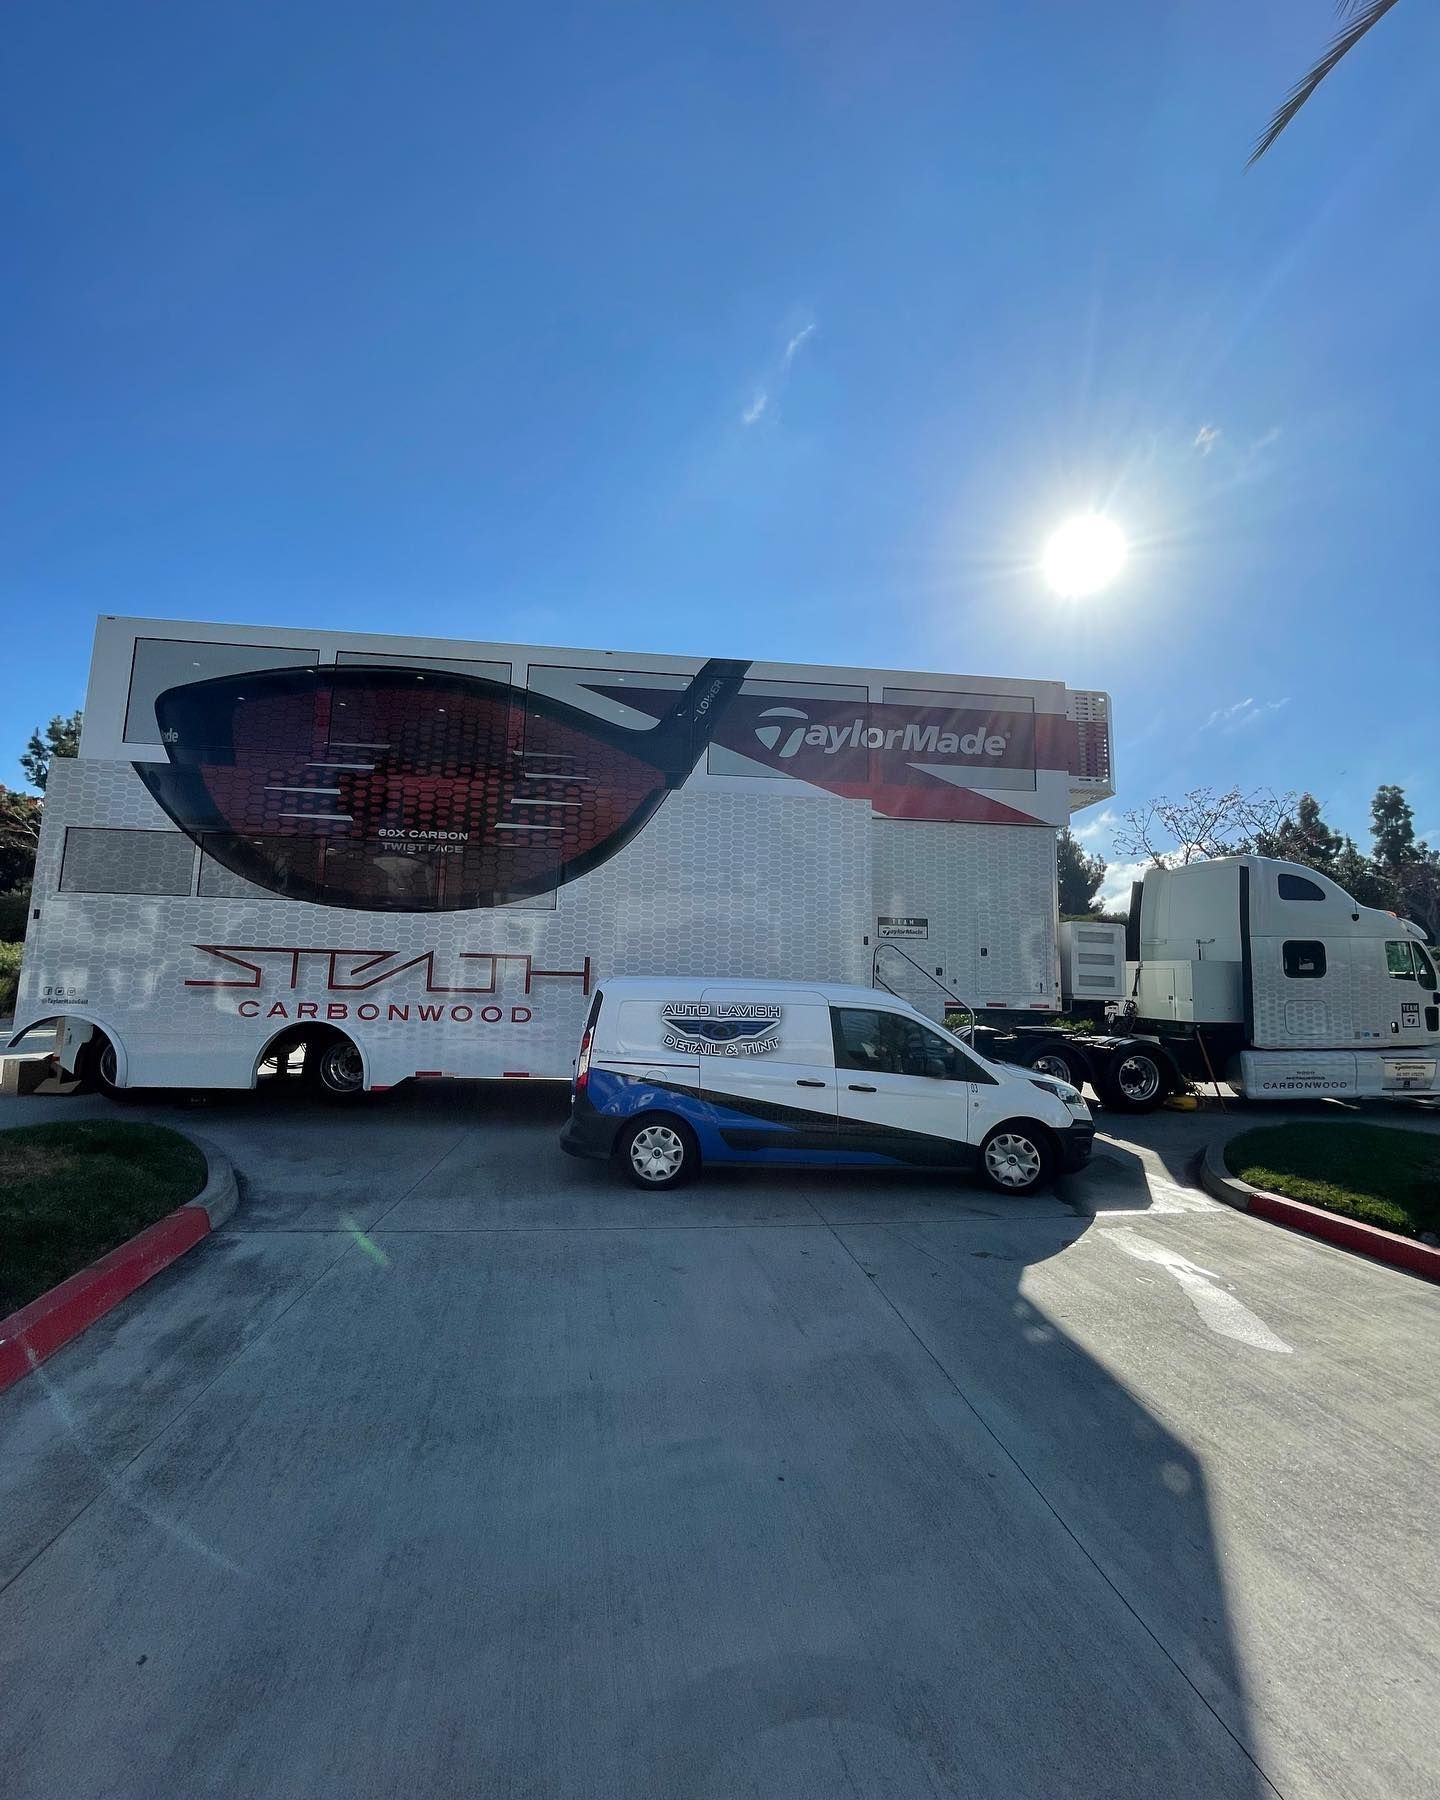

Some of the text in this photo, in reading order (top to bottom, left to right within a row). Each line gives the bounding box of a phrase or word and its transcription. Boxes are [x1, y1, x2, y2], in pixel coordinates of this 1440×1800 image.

[696, 679, 724, 715] LOWER
[754, 706, 1007, 758] TaylorMade
[378, 828, 469, 841] 60X CARBON
[382, 842, 464, 854] TWIST FACE
[238, 1000, 533, 1024] CARBONWOOD
[662, 1003, 781, 1018] AUTO LAVISH
[663, 1033, 780, 1056] DETAIL & TINT
[1262, 1081, 1348, 1090] CARBONWOOD
